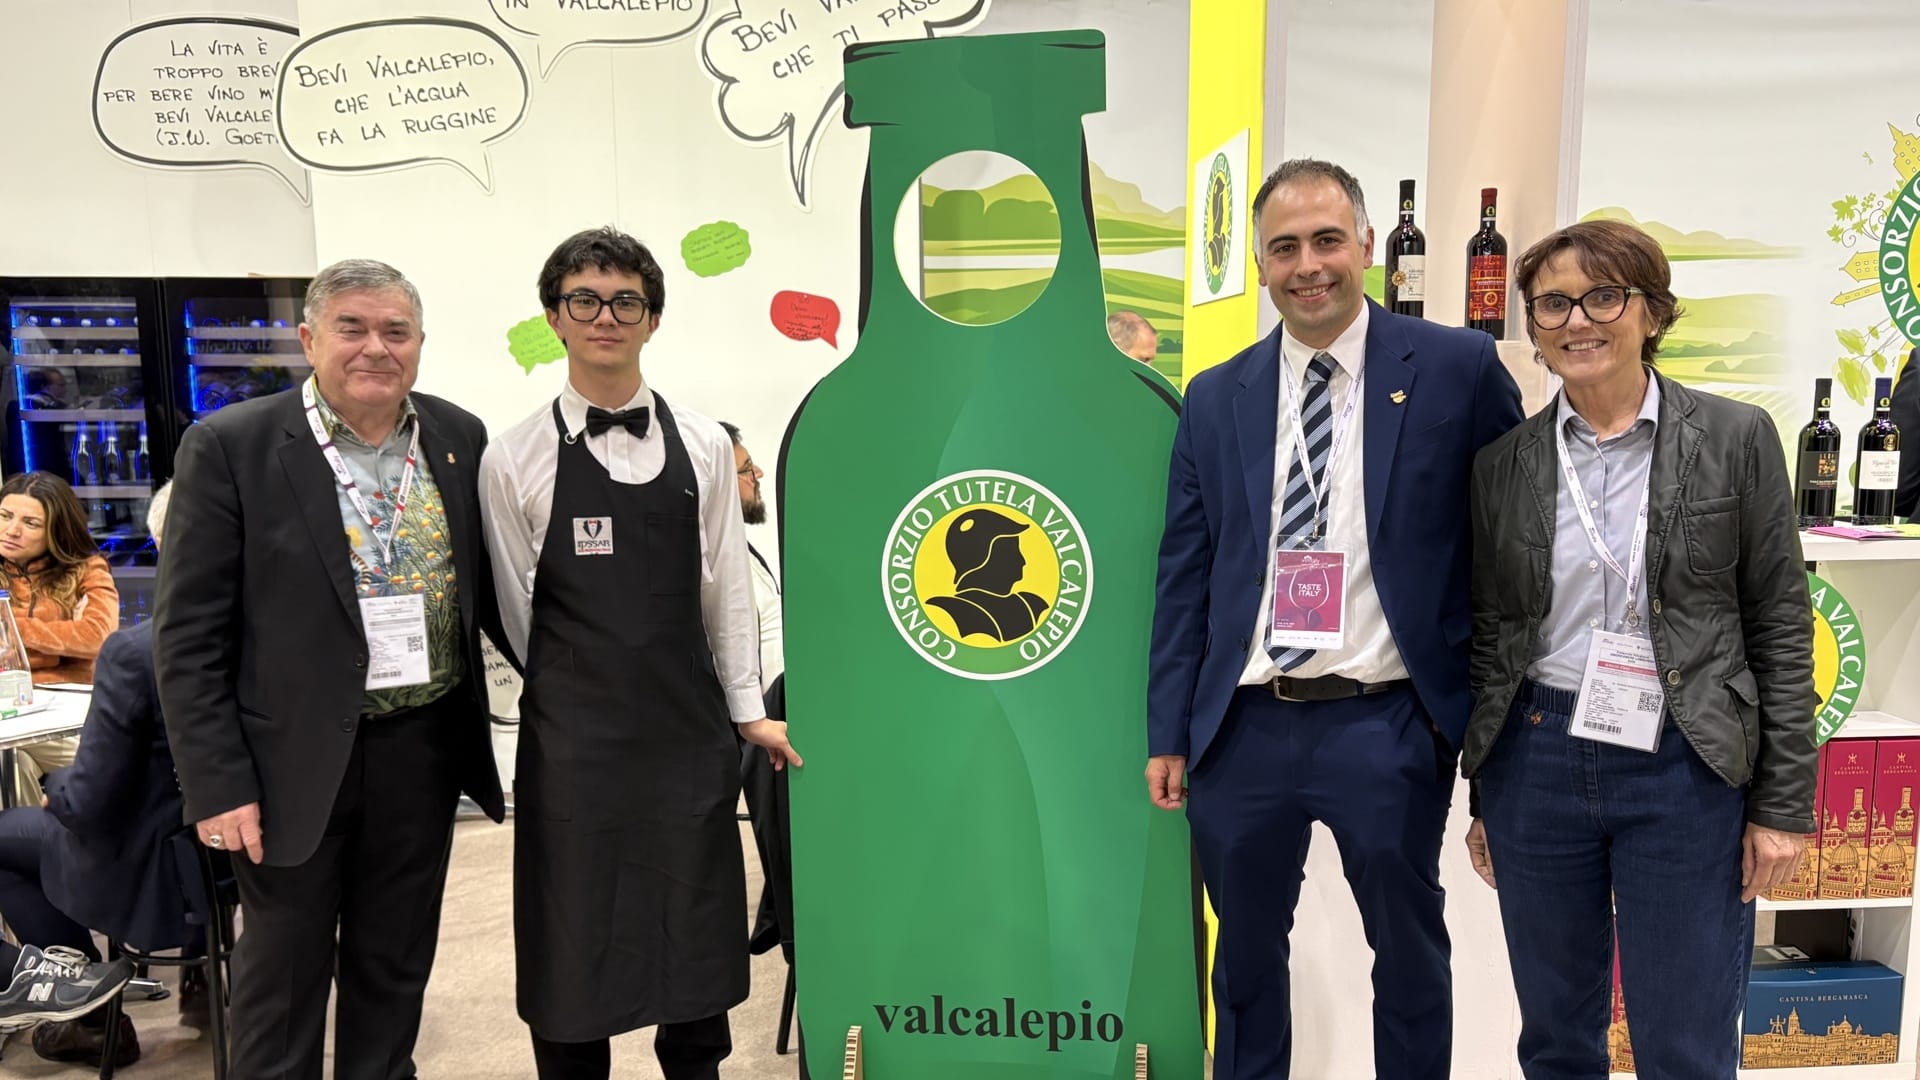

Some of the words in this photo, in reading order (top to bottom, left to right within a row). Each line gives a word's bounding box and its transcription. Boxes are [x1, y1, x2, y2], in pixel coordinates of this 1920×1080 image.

[171, 39, 194, 57] LA
[208, 38, 244, 56] VITA
[257, 36, 268, 55] È
[731, 8, 797, 52] BEVI
[773, 44, 814, 78] CHE
[833, 24, 860, 46] TI
[877, 0, 941, 27] PAS
[154, 66, 223, 79] TROPPO
[293, 64, 348, 88] BEVI
[366, 51, 494, 79] VALCALEPIO,
[104, 89, 136, 103] PER
[150, 87, 193, 103] BERE
[207, 83, 245, 101] VINO
[334, 93, 369, 115] CHE
[389, 82, 470, 107] L'ACQUA
[155, 107, 190, 124] BEVI
[205, 103, 273, 123] VALCALE
[318, 130, 343, 147] FA
[362, 122, 386, 141] LA
[402, 106, 497, 136] RUGGINE
[225, 126, 279, 145] GOET
[891, 507, 957, 661] CONSORZIO
[934, 480, 1037, 517] TUTELA
[1019, 507, 1083, 661] VALCALEPIO
[1297, 583, 1322, 591] TASTE
[1817, 602, 1862, 742] VALCALEP
[1779, 995, 1815, 1003] CANTINA
[1817, 994, 1869, 1002] BERGAMASCA
[873, 995, 1124, 1052] valcalepio
